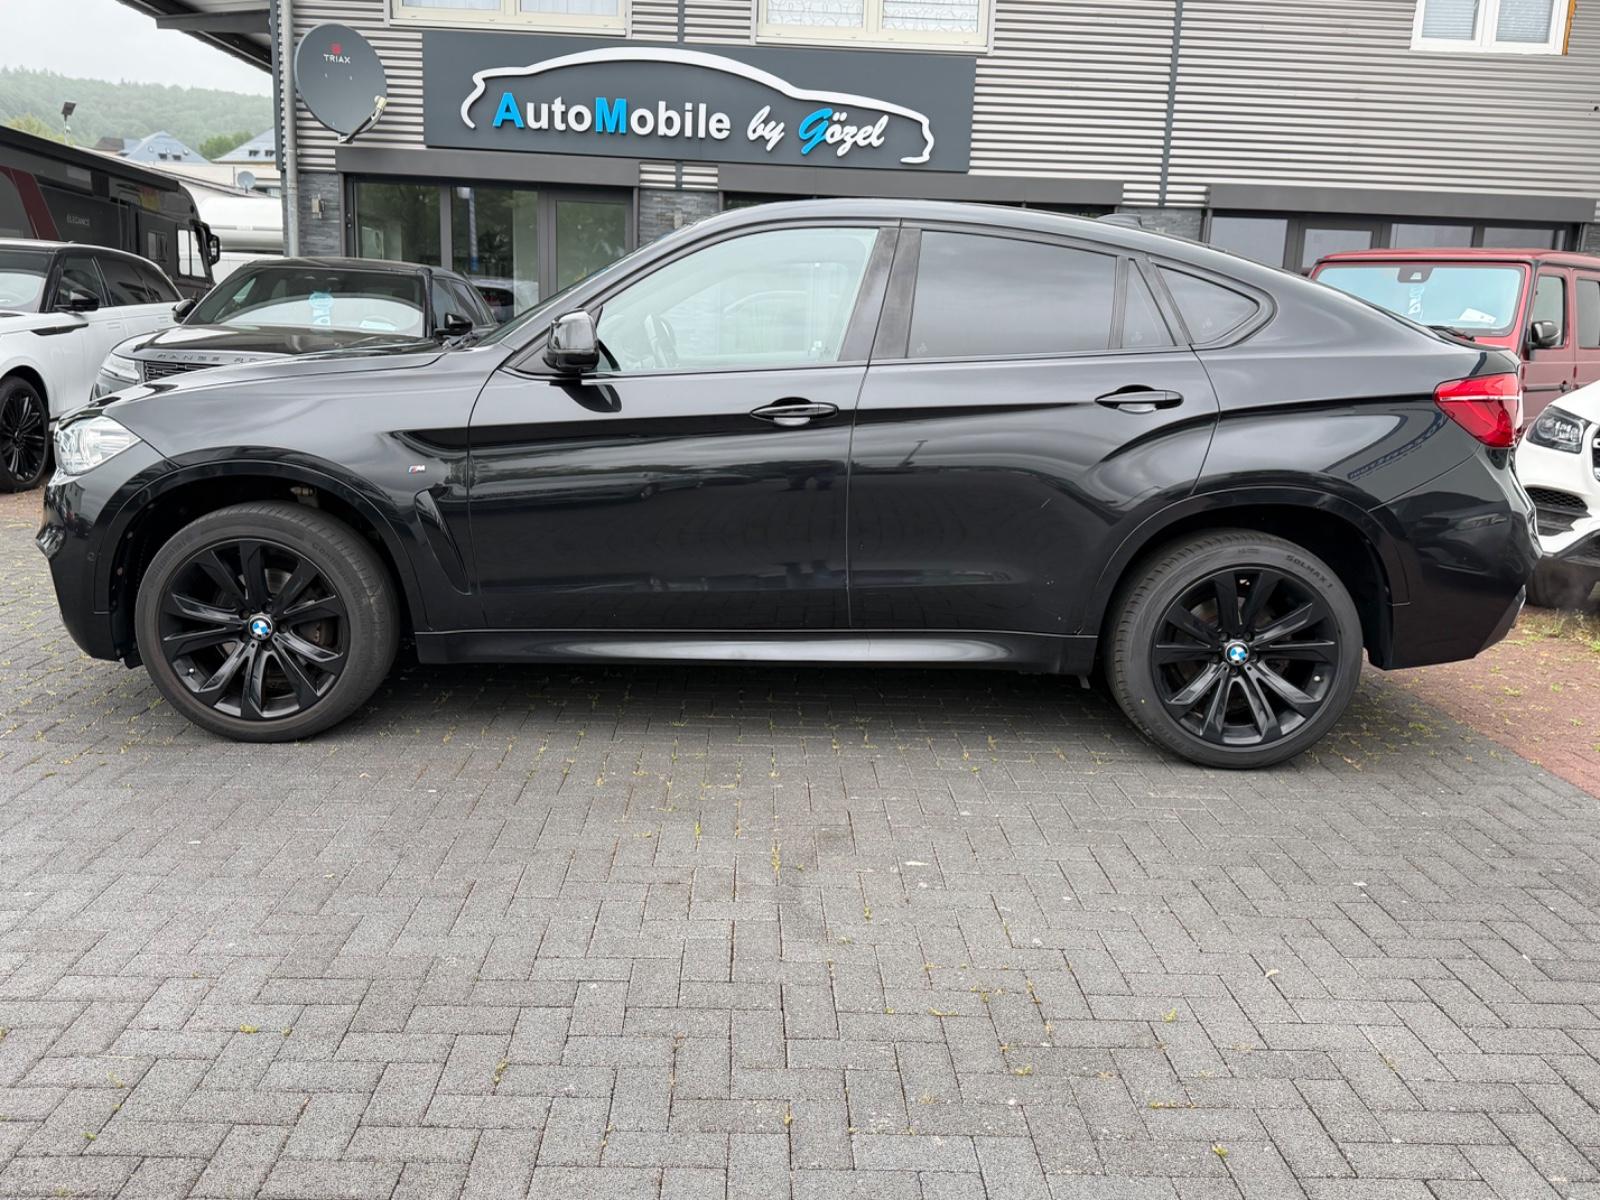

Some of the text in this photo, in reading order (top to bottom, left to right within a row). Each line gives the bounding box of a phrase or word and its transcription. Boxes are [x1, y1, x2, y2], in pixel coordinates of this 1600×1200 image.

[323, 53, 351, 64] TRIAX
[492, 92, 889, 157] AutoMobile by Gözel
